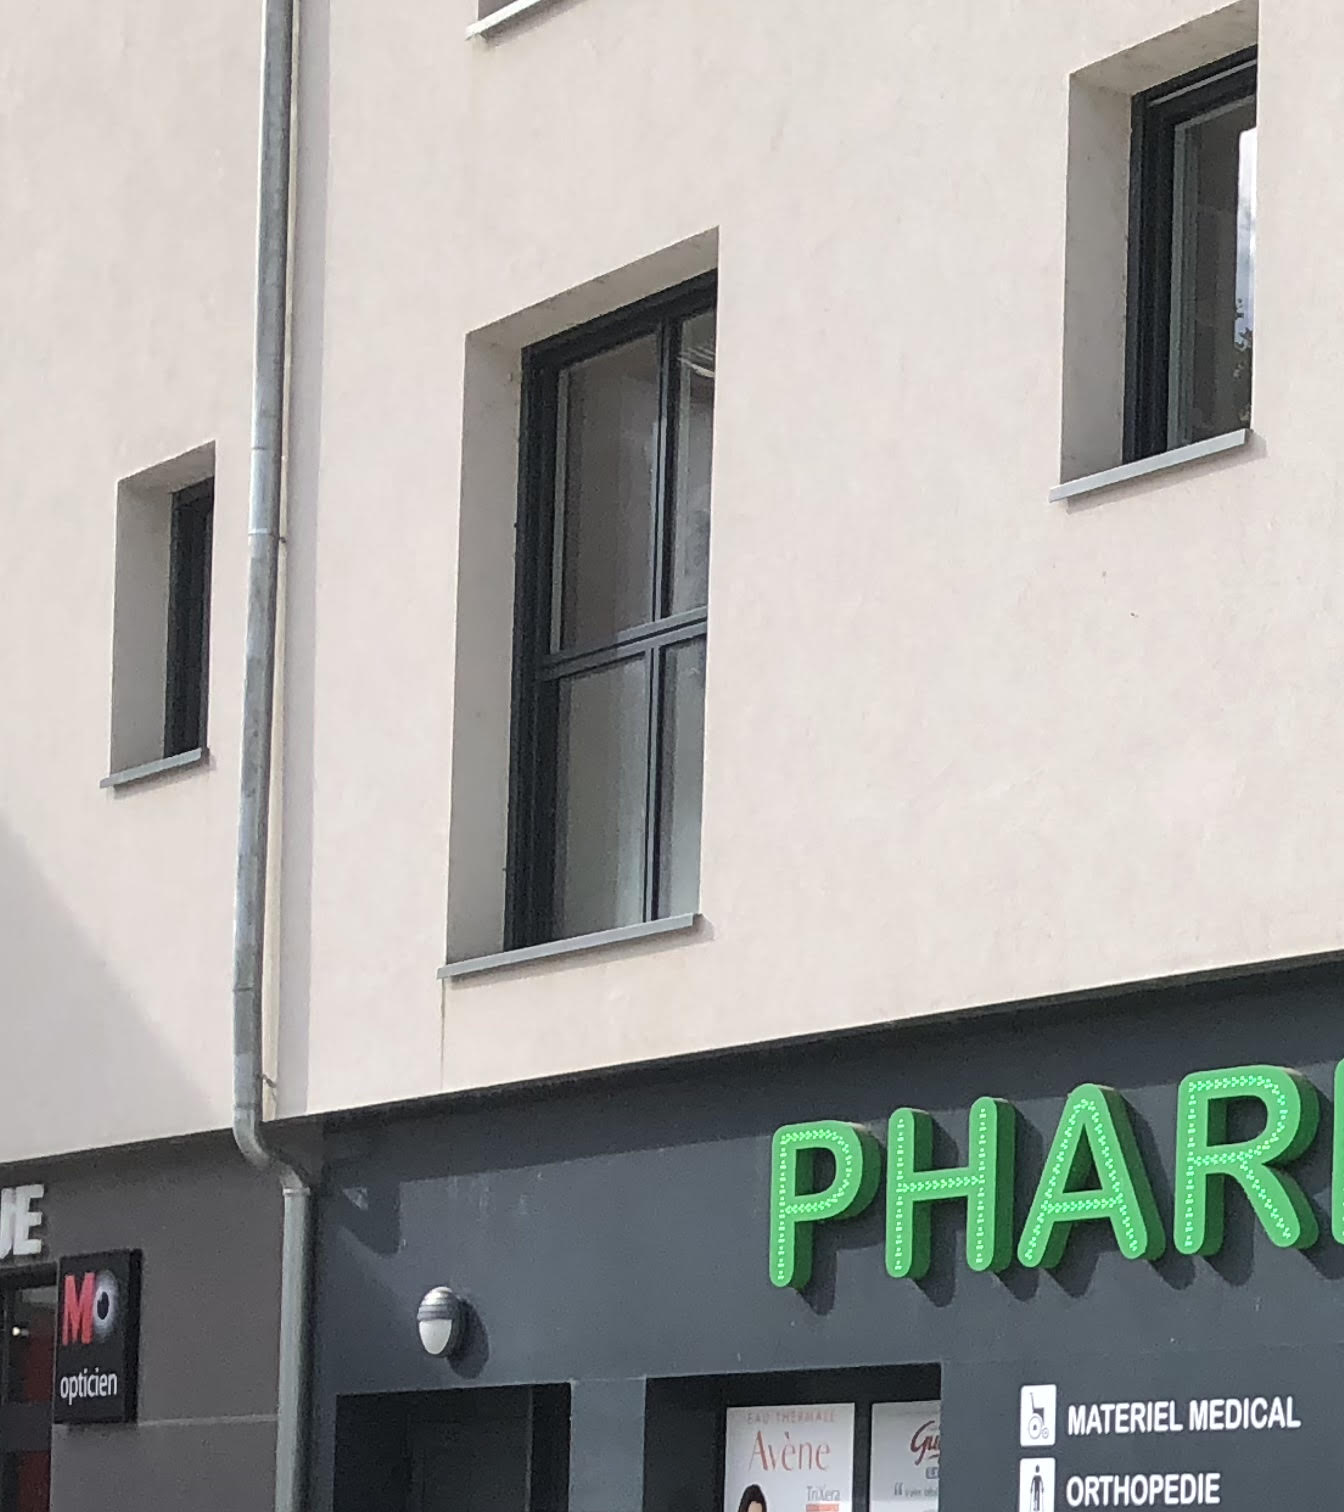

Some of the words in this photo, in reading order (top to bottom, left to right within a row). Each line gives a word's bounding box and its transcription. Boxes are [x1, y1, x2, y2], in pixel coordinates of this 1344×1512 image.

[60, 1368, 118, 1405] opticien
[1068, 1400, 1183, 1435] MATERIEL
[1190, 1397, 1301, 1432] MEDICAL
[748, 1430, 830, 1472] Avène
[1066, 1473, 1221, 1507] ORTHOPEDIE
